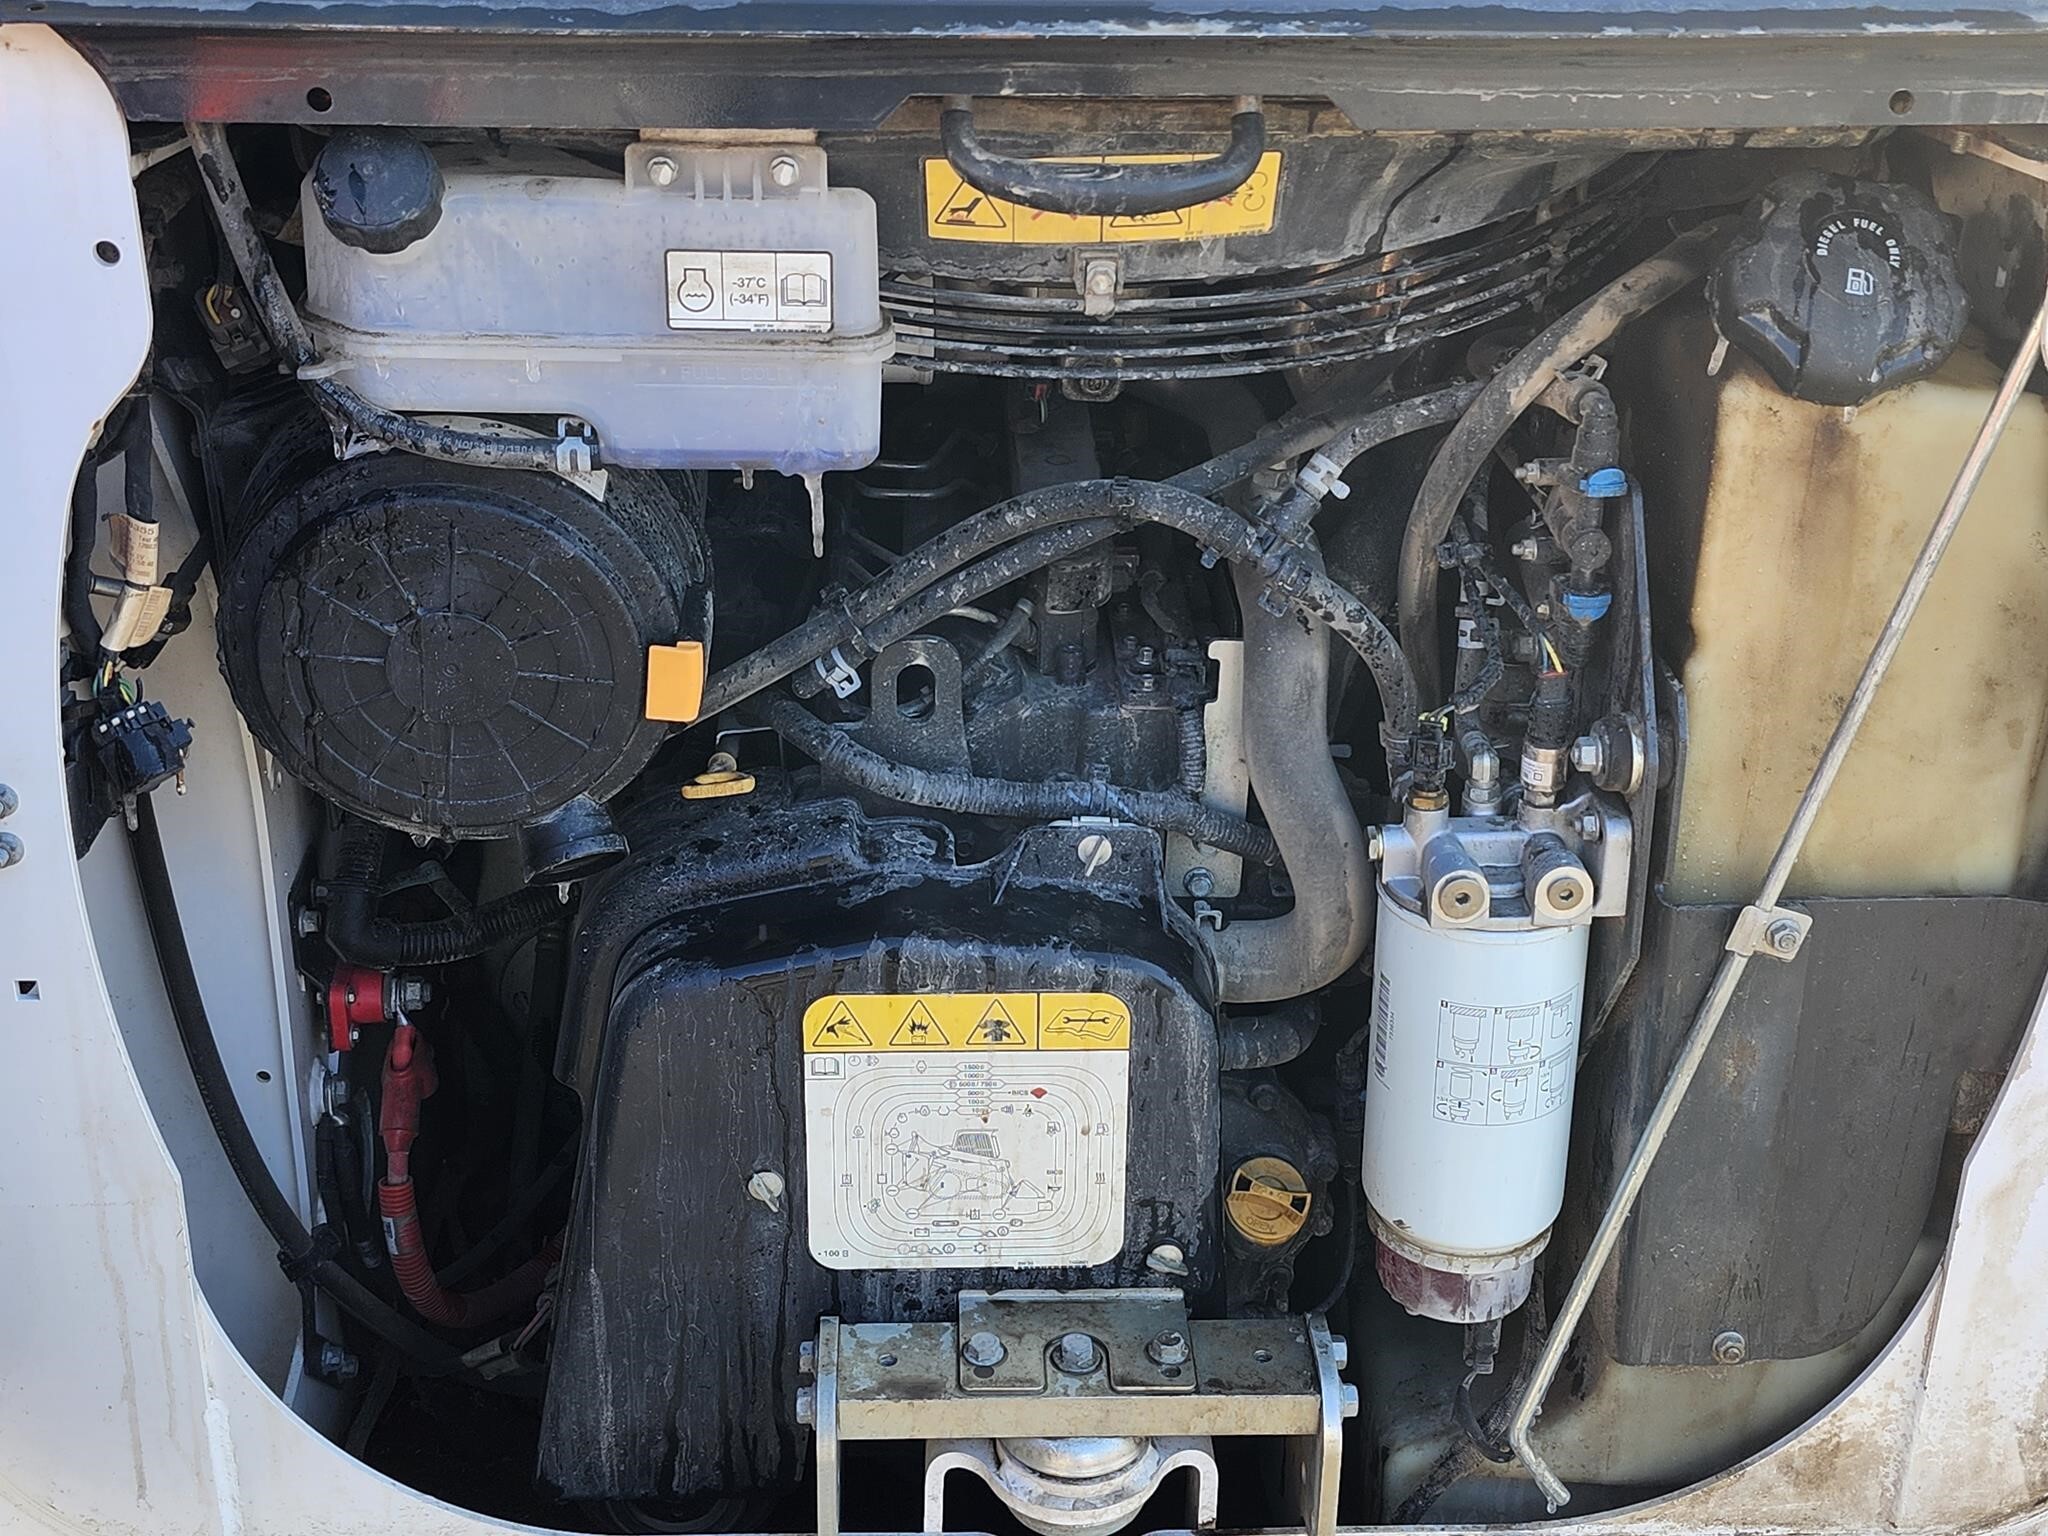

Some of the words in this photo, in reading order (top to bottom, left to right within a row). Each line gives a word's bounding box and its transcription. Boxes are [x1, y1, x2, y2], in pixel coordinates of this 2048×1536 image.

[1816, 220, 1846, 256] DIESEL
[1853, 218, 1884, 237] FUEL
[1885, 238, 1902, 268] ONLY
[1246, 1215, 1275, 1232] OPEN
